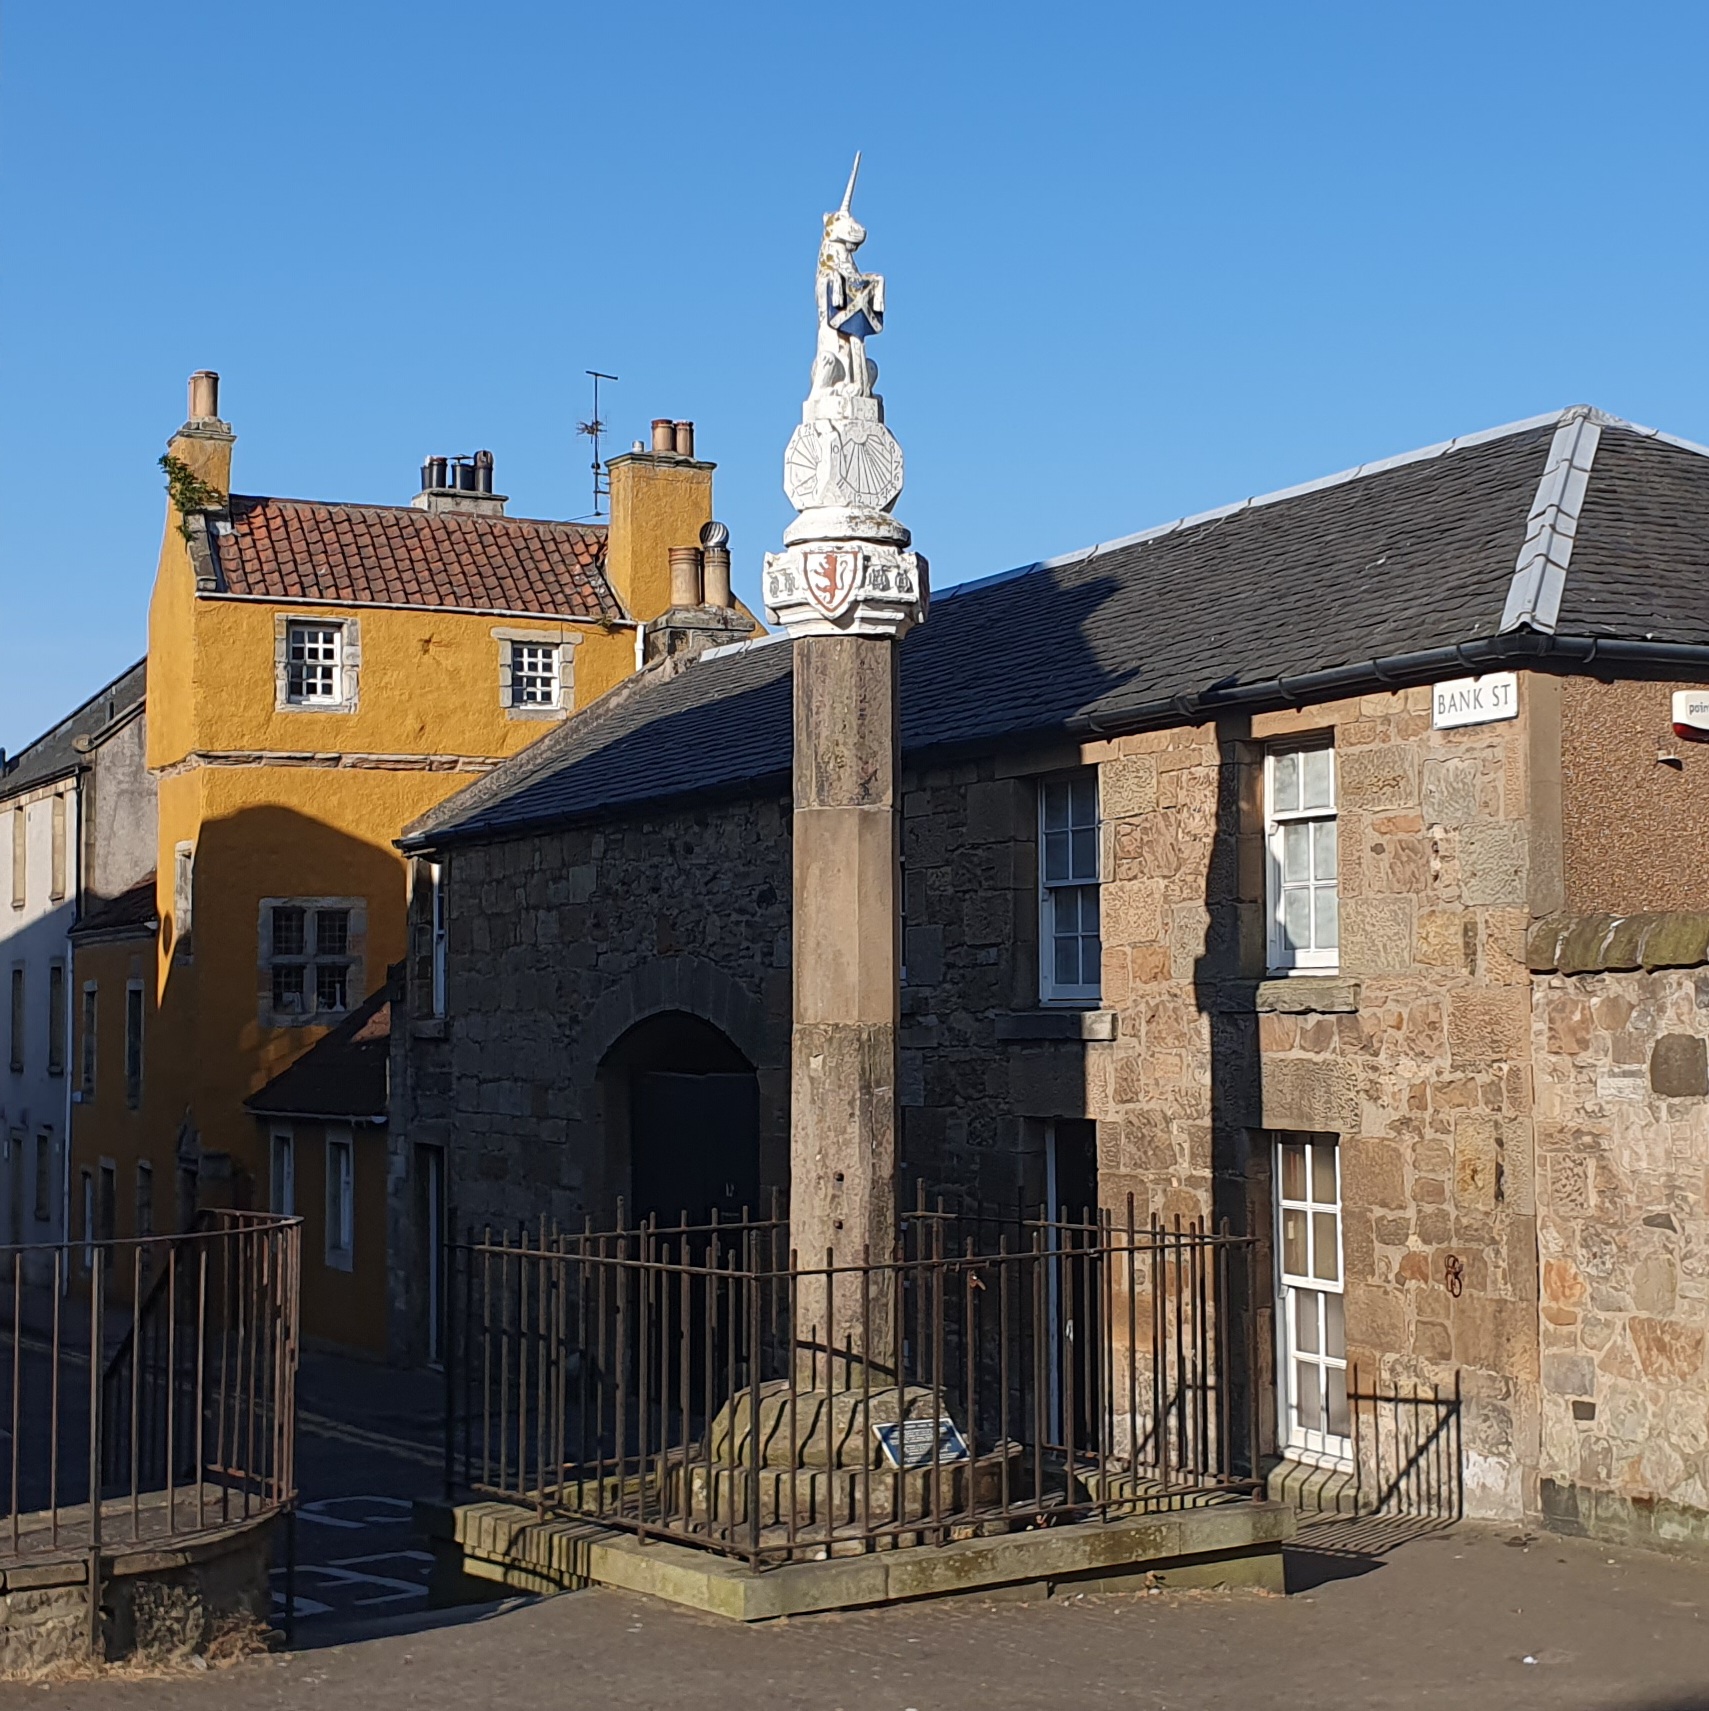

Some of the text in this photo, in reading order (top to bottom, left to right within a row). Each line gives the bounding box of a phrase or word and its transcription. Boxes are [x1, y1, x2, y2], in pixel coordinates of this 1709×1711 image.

[830, 441, 840, 455] 10
[893, 460, 901, 471] 7
[893, 472, 900, 481] 6
[853, 493, 864, 504] 12
[1438, 684, 1511, 715] BANK ST
[1689, 701, 1709, 715] poin
